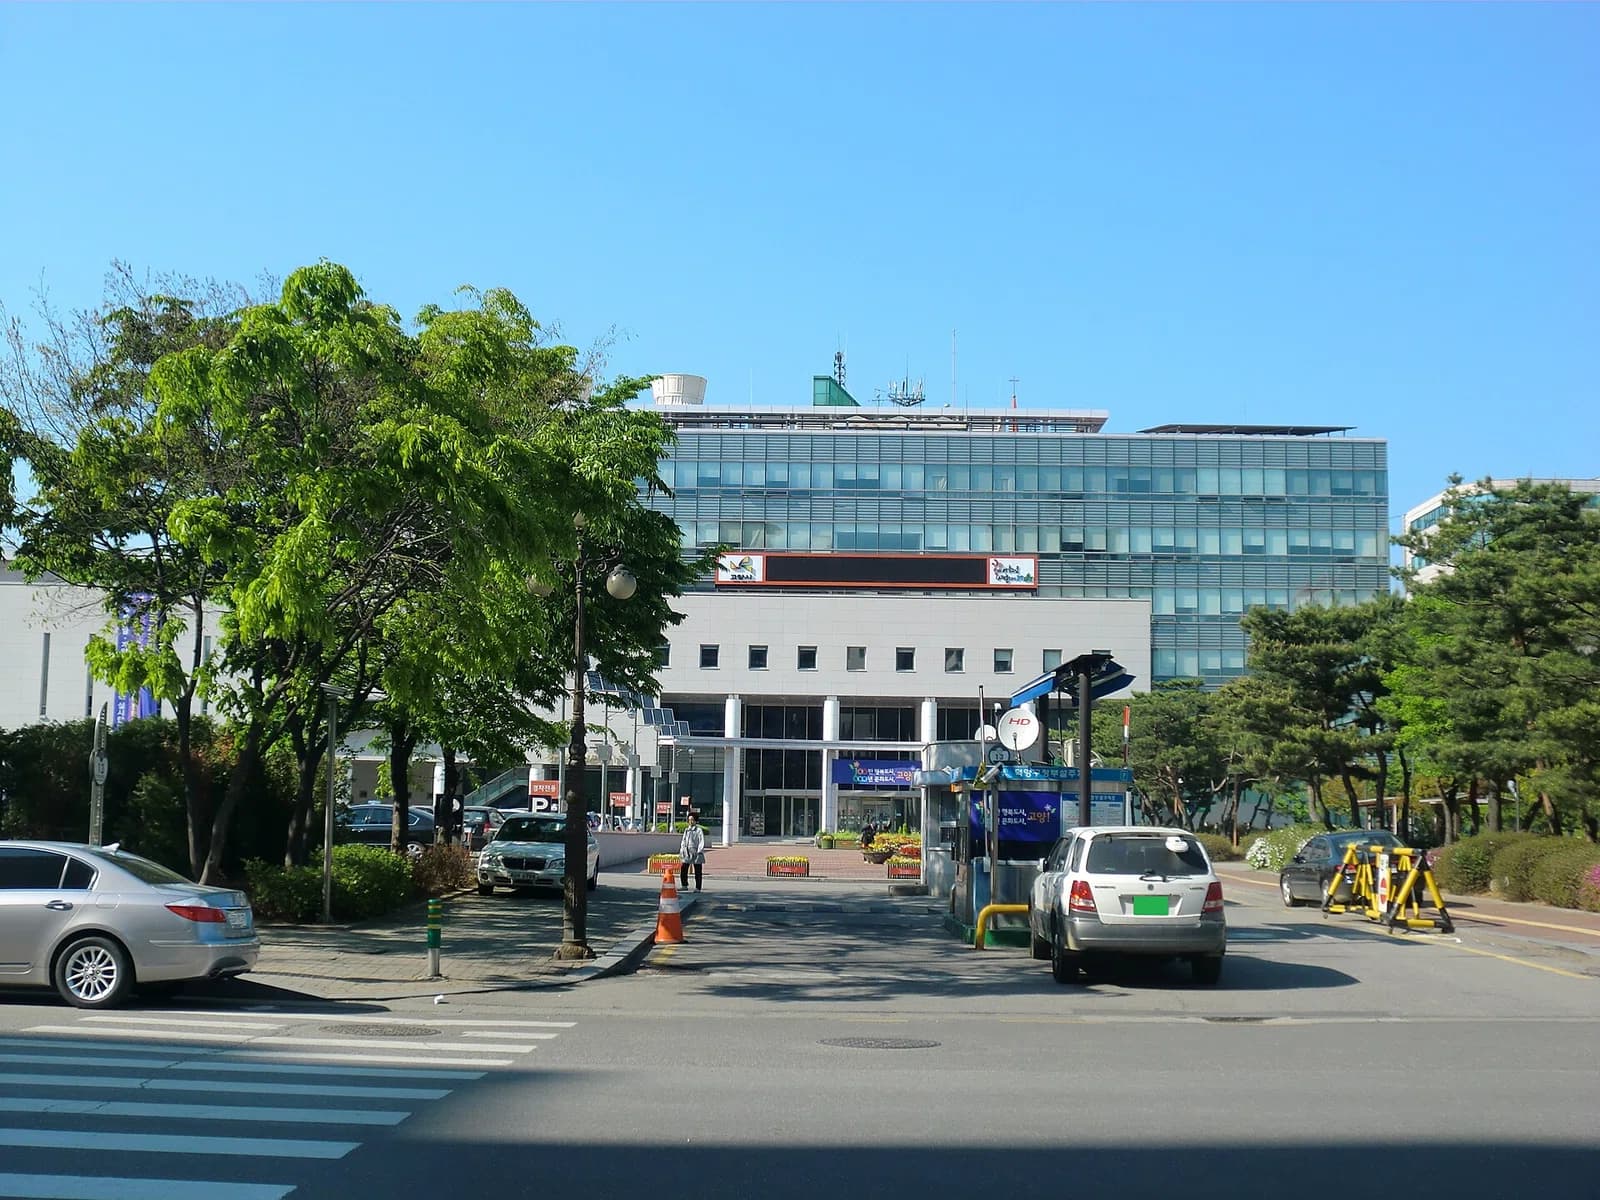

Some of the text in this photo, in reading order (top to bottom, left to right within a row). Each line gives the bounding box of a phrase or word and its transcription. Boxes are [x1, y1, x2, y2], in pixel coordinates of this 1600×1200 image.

[1008, 717, 1031, 726] HD
[532, 797, 549, 812] P
[1027, 811, 1050, 824] 고양!
